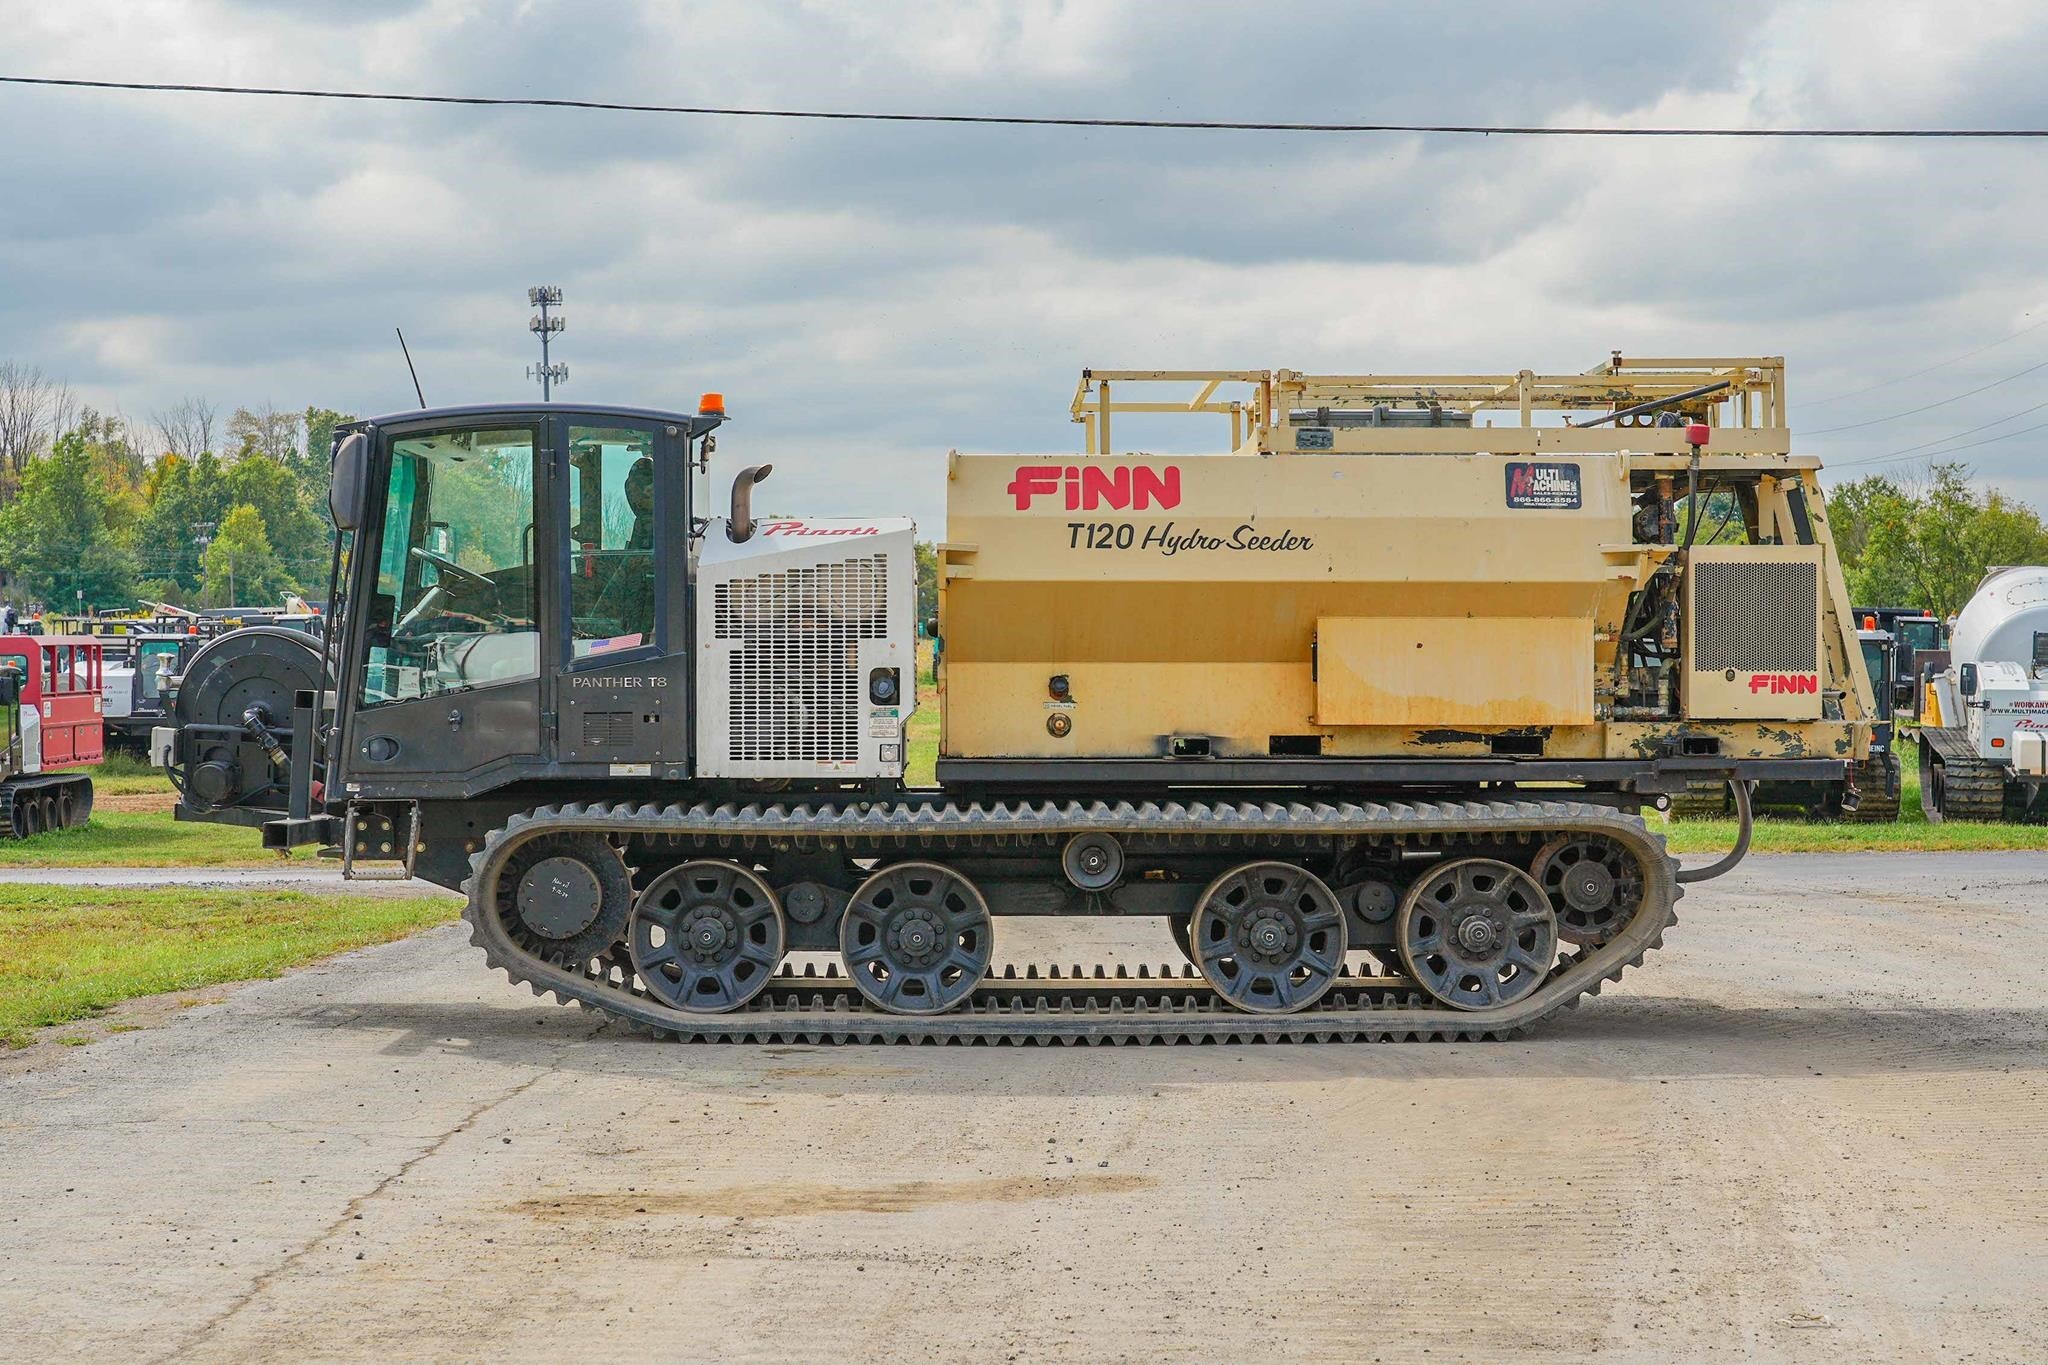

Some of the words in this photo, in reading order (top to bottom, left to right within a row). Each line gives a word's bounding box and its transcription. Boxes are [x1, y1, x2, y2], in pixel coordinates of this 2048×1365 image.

[761, 521, 879, 537] Prinoth
[1067, 522, 1135, 550] T120
[572, 677, 643, 689] PANTHER
[648, 676, 668, 688] T8
